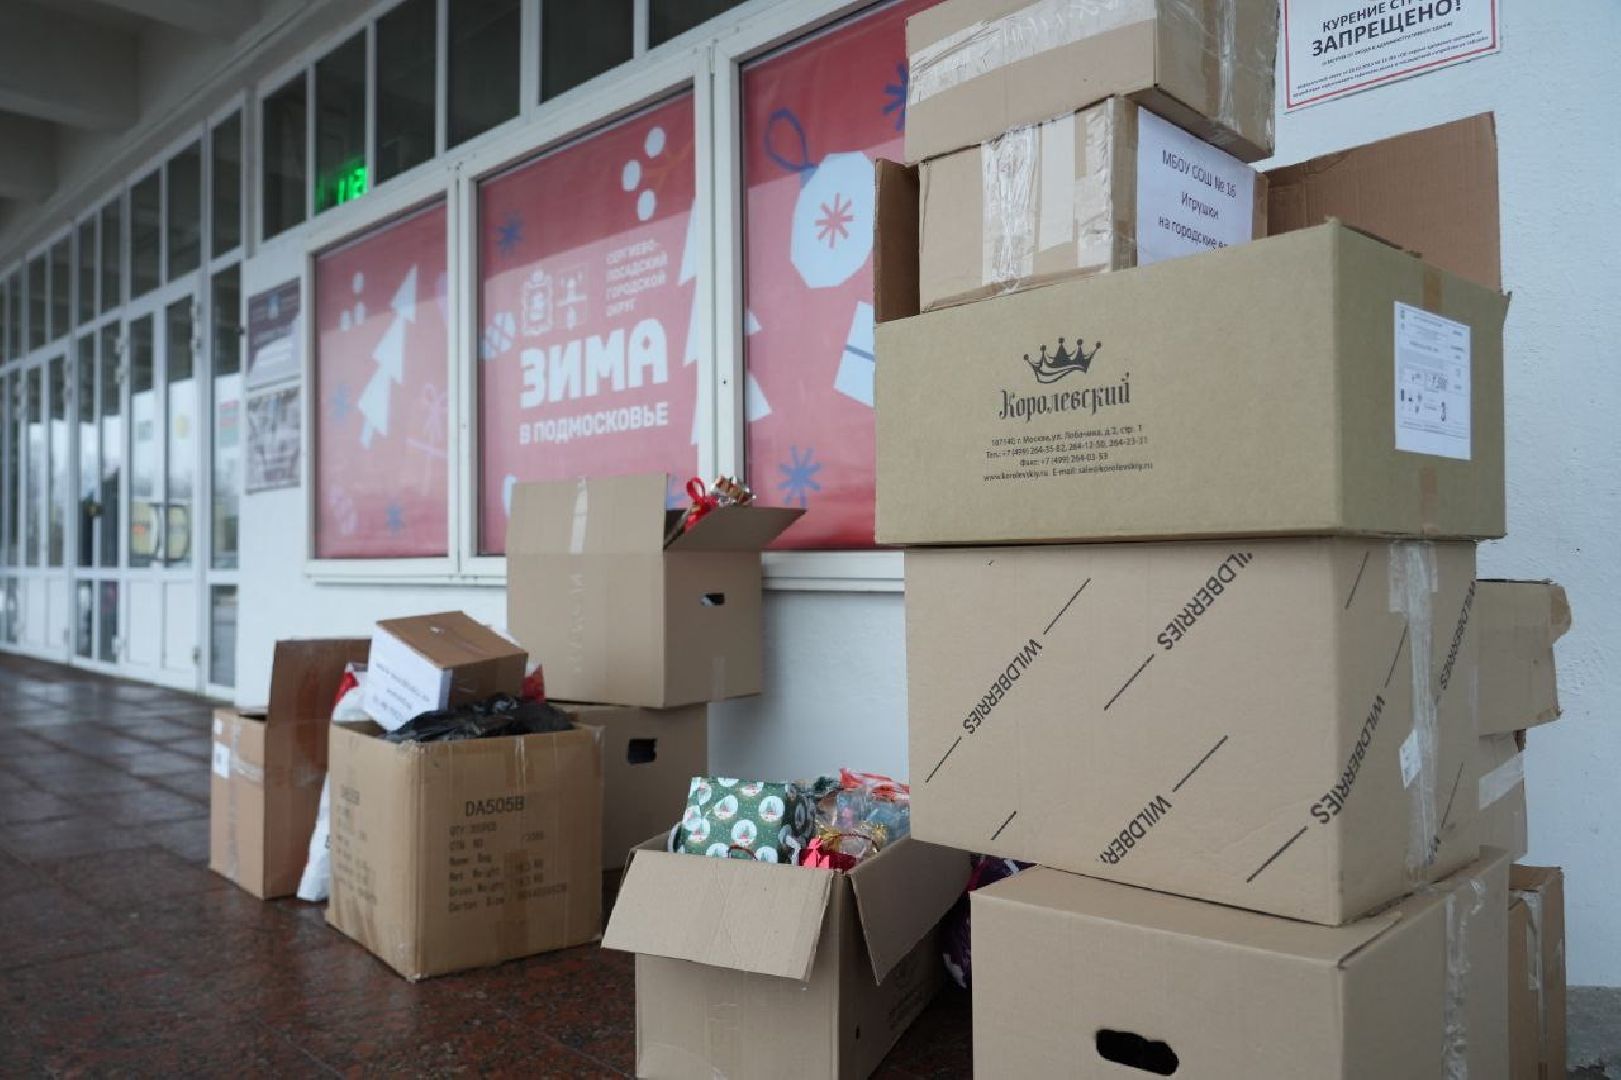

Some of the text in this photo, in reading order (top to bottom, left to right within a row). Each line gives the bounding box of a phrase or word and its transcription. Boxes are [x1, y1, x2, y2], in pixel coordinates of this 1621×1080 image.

[1312, 0, 1462, 57] ЗАПРЕЩЕНО!
[1322, 1, 1386, 32] КУРЕНИЕ
[1161, 149, 1237, 198] МБОУ СОШ № 16
[1158, 216, 1171, 230] на
[1181, 191, 1219, 220] Игрушки
[520, 318, 668, 409] ЗИМА
[519, 401, 669, 445] В ПОДМОСКОВЬЕ
[999, 371, 1132, 423] Королевский
[1157, 552, 1253, 650] ILDBERRIES
[962, 639, 1043, 734] WILDBERRIES
[1310, 695, 1386, 824] WILDBERRIES
